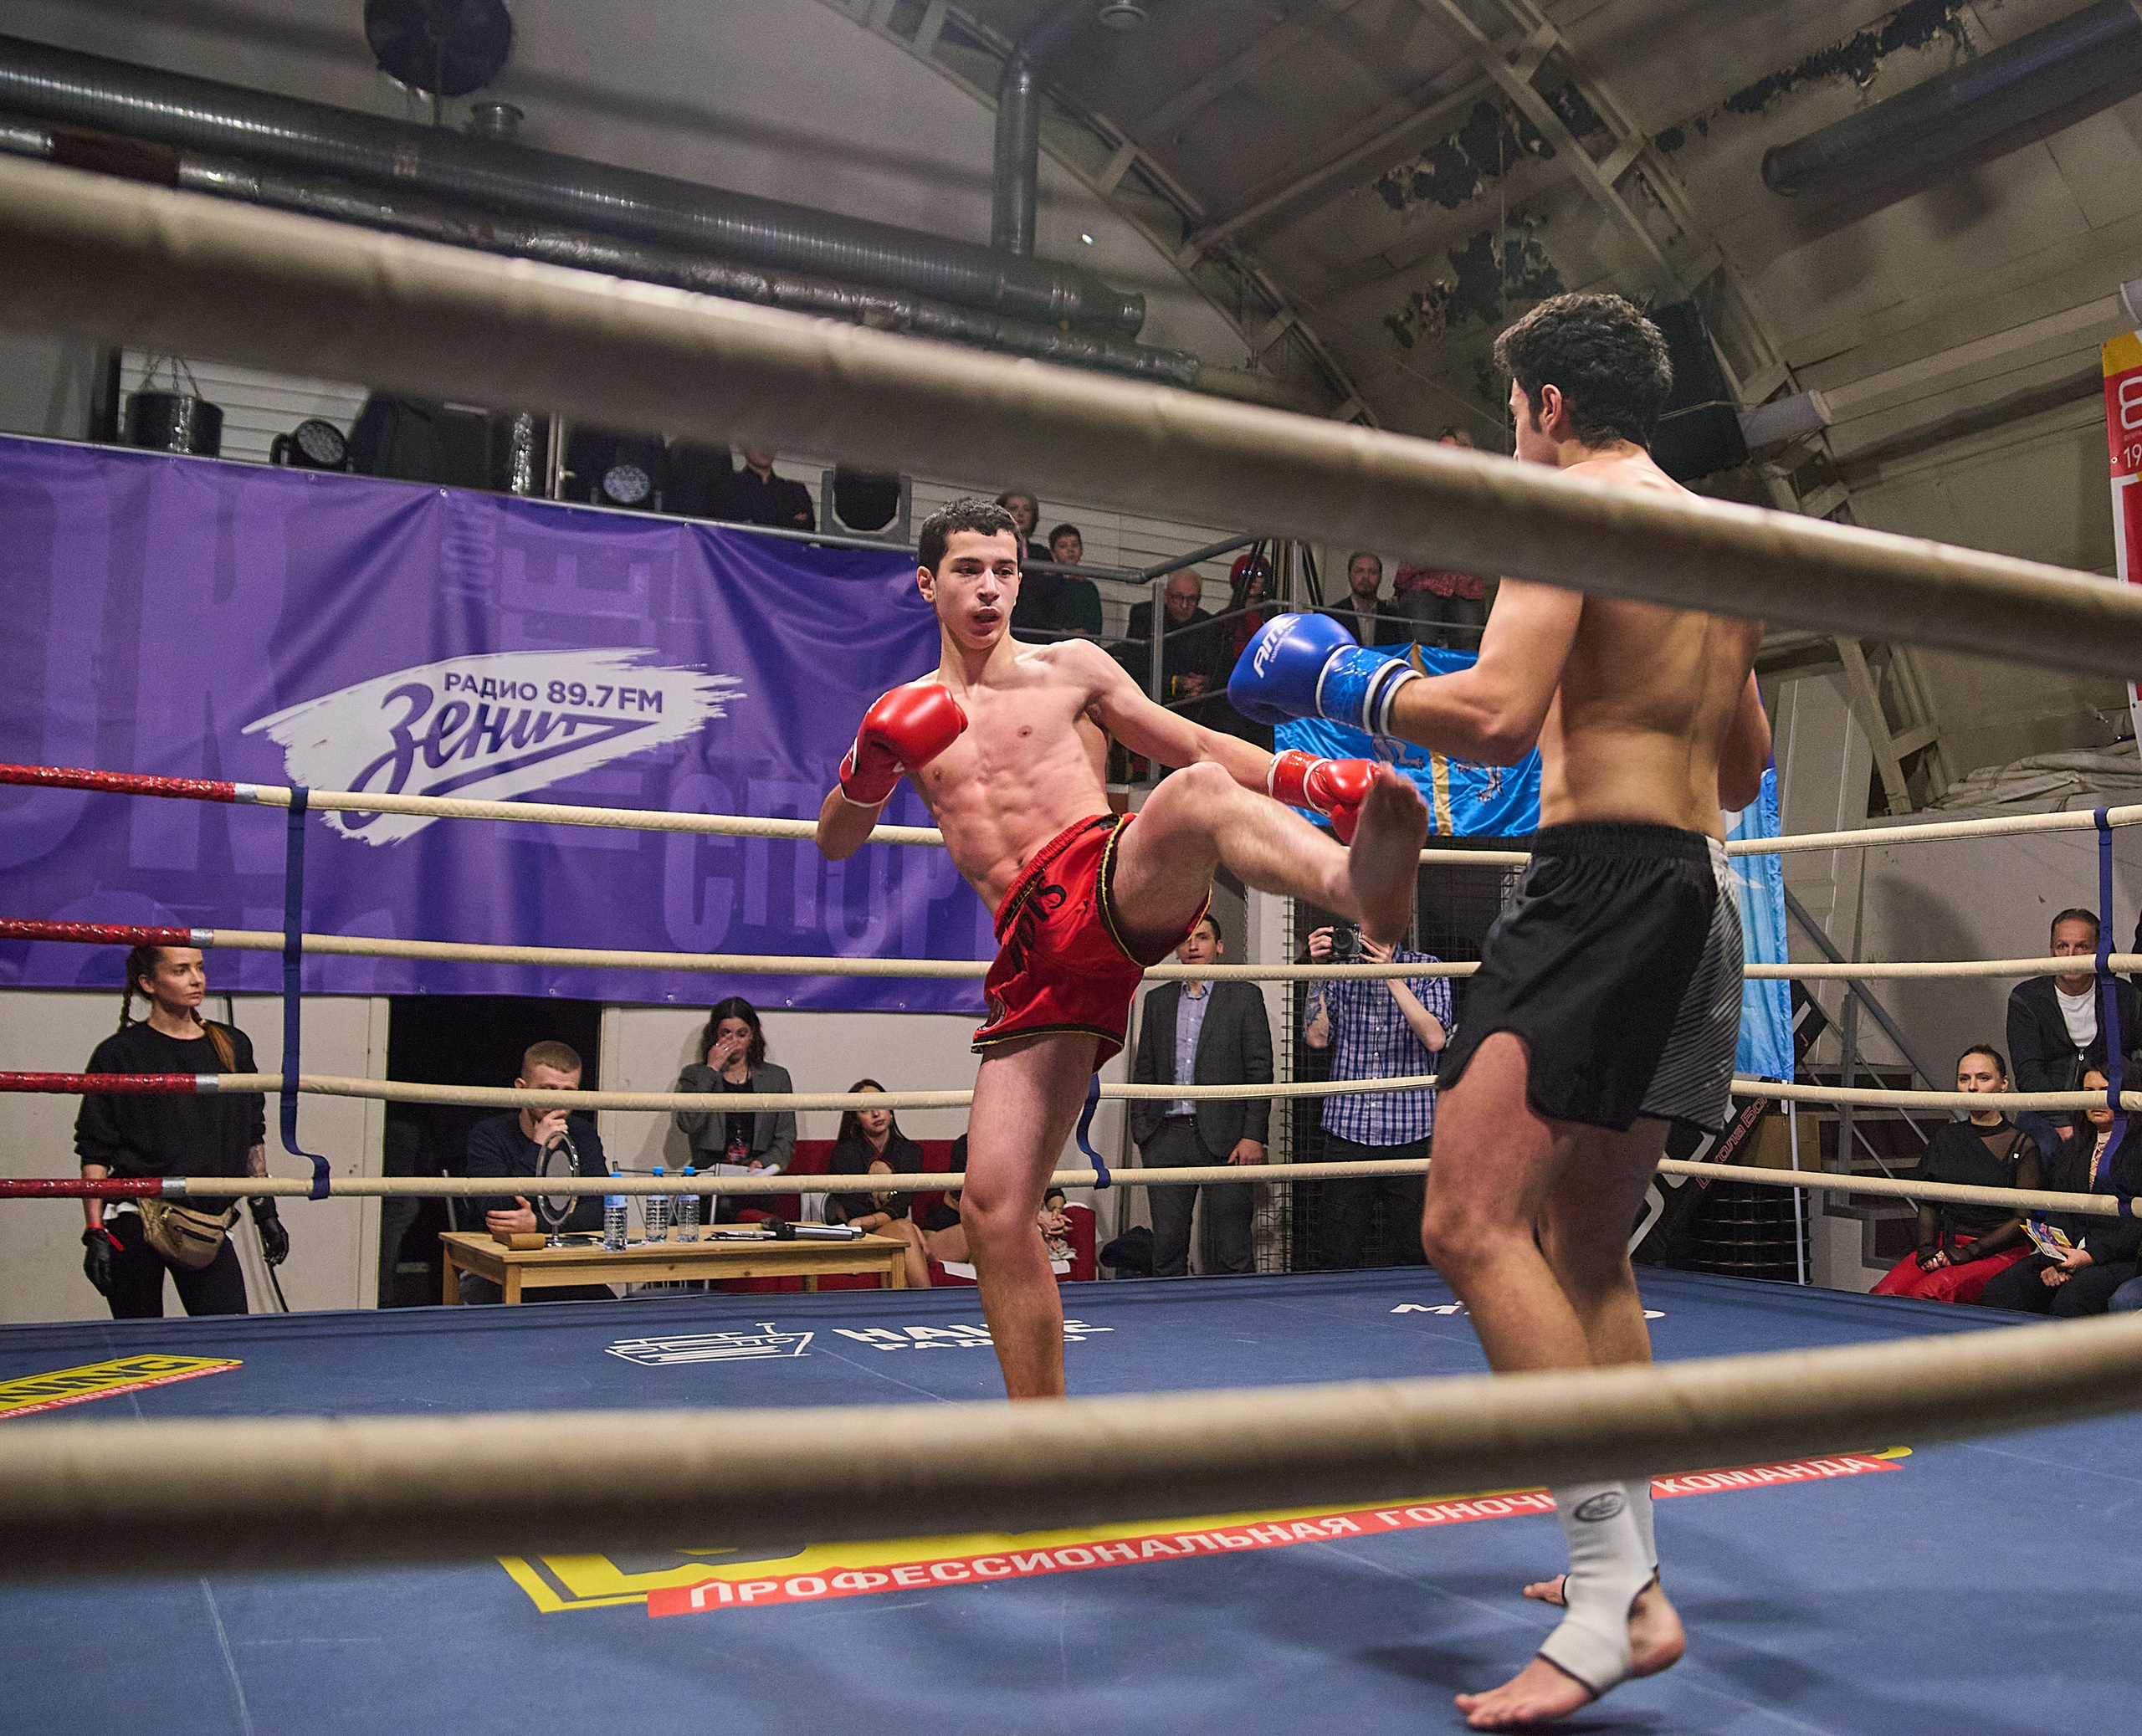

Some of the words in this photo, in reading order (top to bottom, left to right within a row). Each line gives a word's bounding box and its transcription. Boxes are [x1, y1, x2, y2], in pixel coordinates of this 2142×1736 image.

[341, 682, 659, 831] Зенит
[444, 672, 538, 701] РАДИО
[690, 1517, 1359, 1607] ПРОФЕССИОНАЛЬНАЯ
[1653, 1456, 1881, 1494] КОМАНДА
